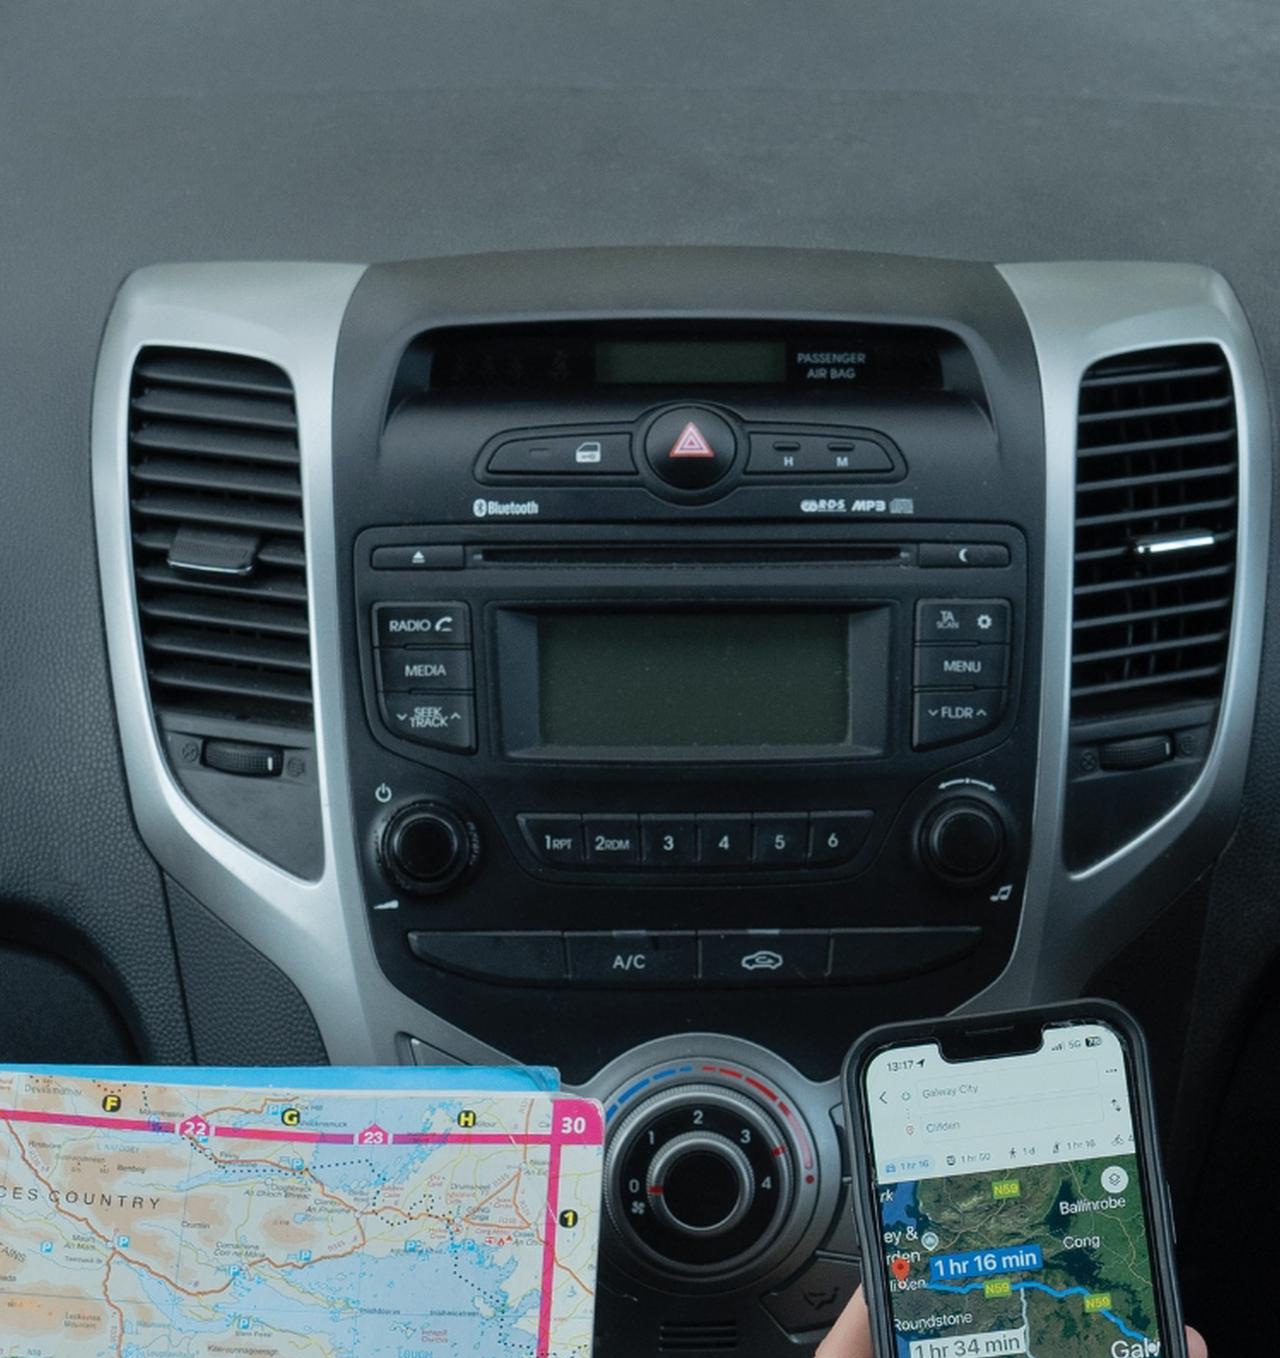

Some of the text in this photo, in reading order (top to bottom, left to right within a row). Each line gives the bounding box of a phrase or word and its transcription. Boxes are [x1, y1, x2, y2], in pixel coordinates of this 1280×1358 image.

[797, 352, 866, 364] PASSENGER
[807, 368, 856, 379] AIR BAG
[784, 456, 794, 467] H
[836, 456, 849, 467] M
[488, 500, 539, 516] Bluetooth
[851, 499, 886, 512] MP3
[940, 610, 955, 622] TA
[389, 619, 431, 632] RADIO
[936, 621, 959, 629] SCAN
[405, 664, 447, 676] MEDIA
[944, 660, 982, 673] MENU
[414, 706, 442, 717] SEEK
[941, 706, 974, 719] FLDR
[409, 716, 448, 728] TRACK
[663, 834, 674, 851] 3
[718, 833, 730, 850] 4
[774, 833, 786, 850] 5
[827, 832, 839, 850] 6
[613, 952, 646, 972] A/C
[1068, 1039, 1081, 1050] 5G
[886, 1060, 914, 1072] 13:17
[922, 1084, 978, 1100] Galway City
[104, 1095, 119, 1111] F
[282, 1110, 298, 1125] G
[459, 1111, 475, 1126] H
[693, 1110, 704, 1124] 2
[183, 1121, 206, 1135] 22
[561, 1117, 586, 1134] 30
[363, 1131, 384, 1144] 23
[648, 1130, 656, 1145] 1
[740, 1129, 751, 1143] 3
[628, 1179, 640, 1193] 0
[761, 1176, 772, 1190] 4
[993, 1183, 1020, 1196] N59
[48, 1189, 161, 1210] COUNTRY
[1059, 1195, 1126, 1216] Ballinrobe
[562, 1210, 574, 1226] 1
[906, 1226, 919, 1241] &
[1062, 1234, 1101, 1252] Cong
[934, 1250, 1037, 1277] 1 hr 16 min
[985, 1283, 1010, 1295] N59
[954, 1339, 980, 1357] 34
[985, 1334, 1020, 1355] min
